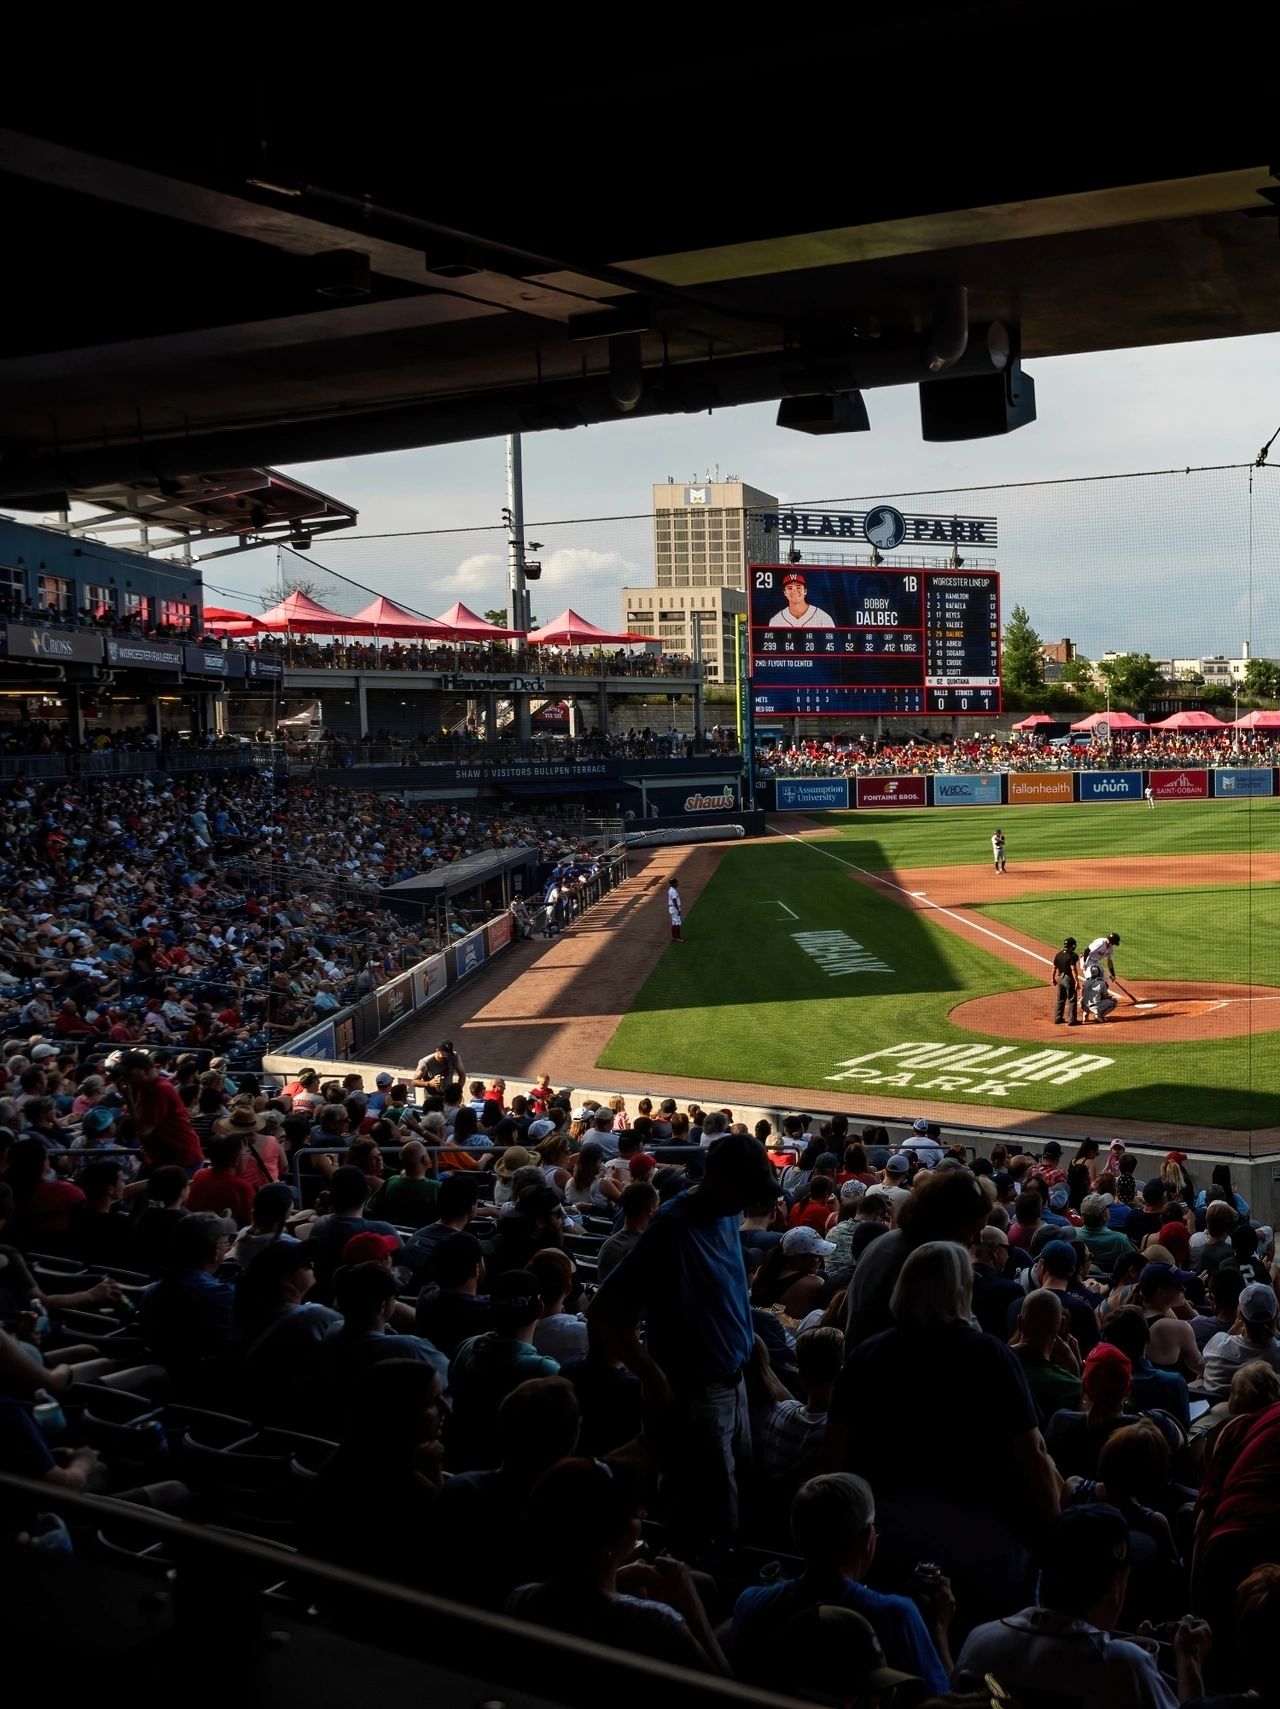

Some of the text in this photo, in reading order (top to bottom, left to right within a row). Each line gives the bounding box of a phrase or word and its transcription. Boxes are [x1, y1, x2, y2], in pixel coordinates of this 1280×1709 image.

[763, 513, 986, 542] POLAR PARK
[755, 572, 773, 589] 29
[903, 576, 917, 592] 1B
[932, 577, 990, 588] WORCESTER LINEUP
[864, 598, 890, 610] BOBBY
[856, 611, 898, 626] DALBEC
[785, 642, 794, 651] 64
[805, 642, 815, 651] 20
[825, 643, 835, 651] 45
[845, 643, 854, 652] 52
[865, 643, 874, 652] 32
[882, 643, 895, 652] .412
[900, 644, 917, 652] 1.062
[794, 660, 813, 668] CENTER
[513, 676, 545, 691] Deck
[938, 698, 989, 710] 0 0 1
[455, 765, 606, 779] SHAWS VISITORS BULLPEN TERRACE
[797, 784, 843, 795] Assumption
[1012, 783, 1070, 794] fallonhealth
[1093, 780, 1129, 792] unum
[798, 793, 836, 802] University
[834, 1042, 1116, 1086] POLAR
[824, 1068, 1032, 1097] PARK
